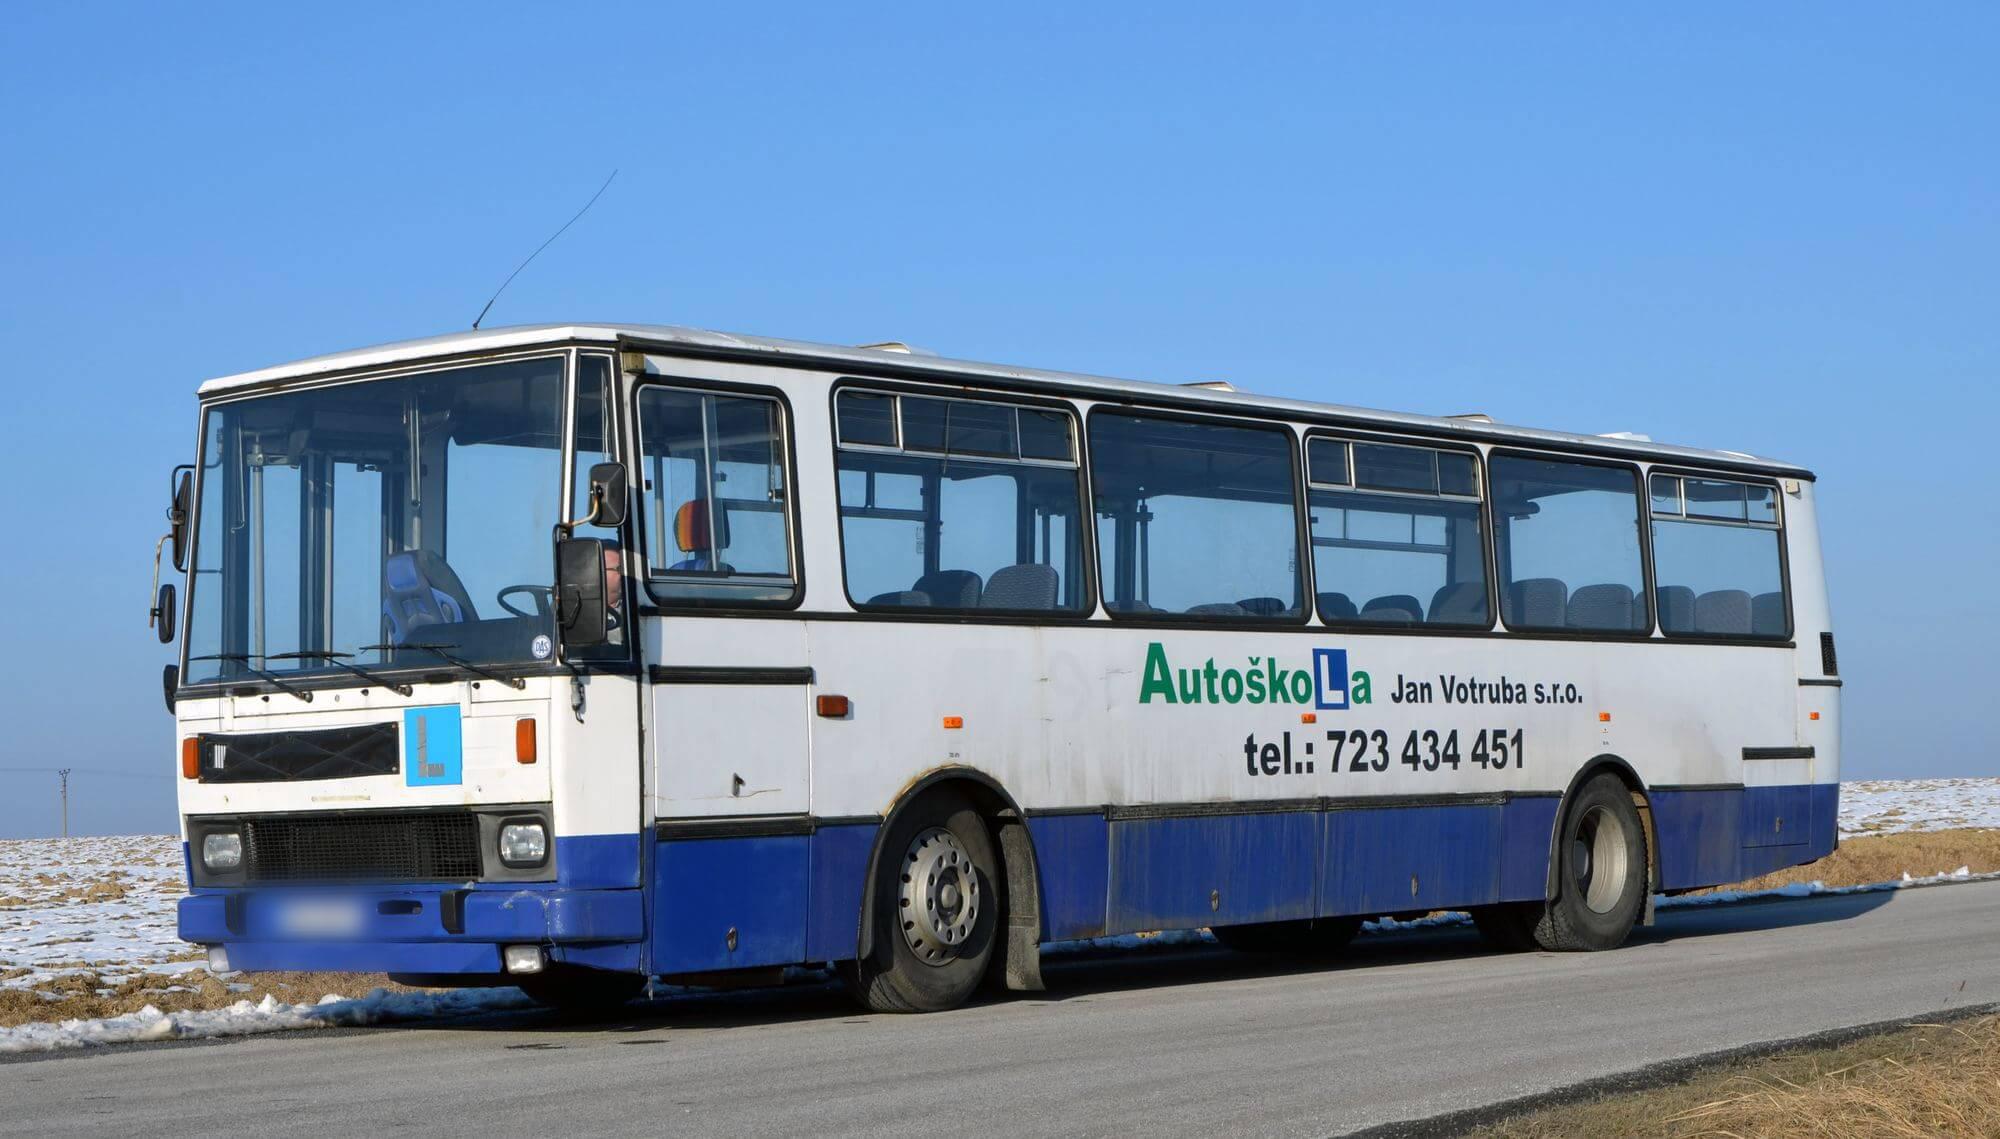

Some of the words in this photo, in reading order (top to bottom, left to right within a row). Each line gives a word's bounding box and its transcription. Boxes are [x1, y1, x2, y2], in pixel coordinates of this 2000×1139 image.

[1139, 641, 1372, 706] AutoškoLa
[1391, 674, 1433, 704] Jan
[1439, 674, 1527, 705] Votruba
[1534, 683, 1583, 705] s.r.o.
[417, 714, 446, 777] L
[1244, 731, 1314, 777] tel.:
[1326, 729, 1390, 773] 723
[1401, 729, 1461, 772] 434
[1470, 728, 1523, 770] 451
